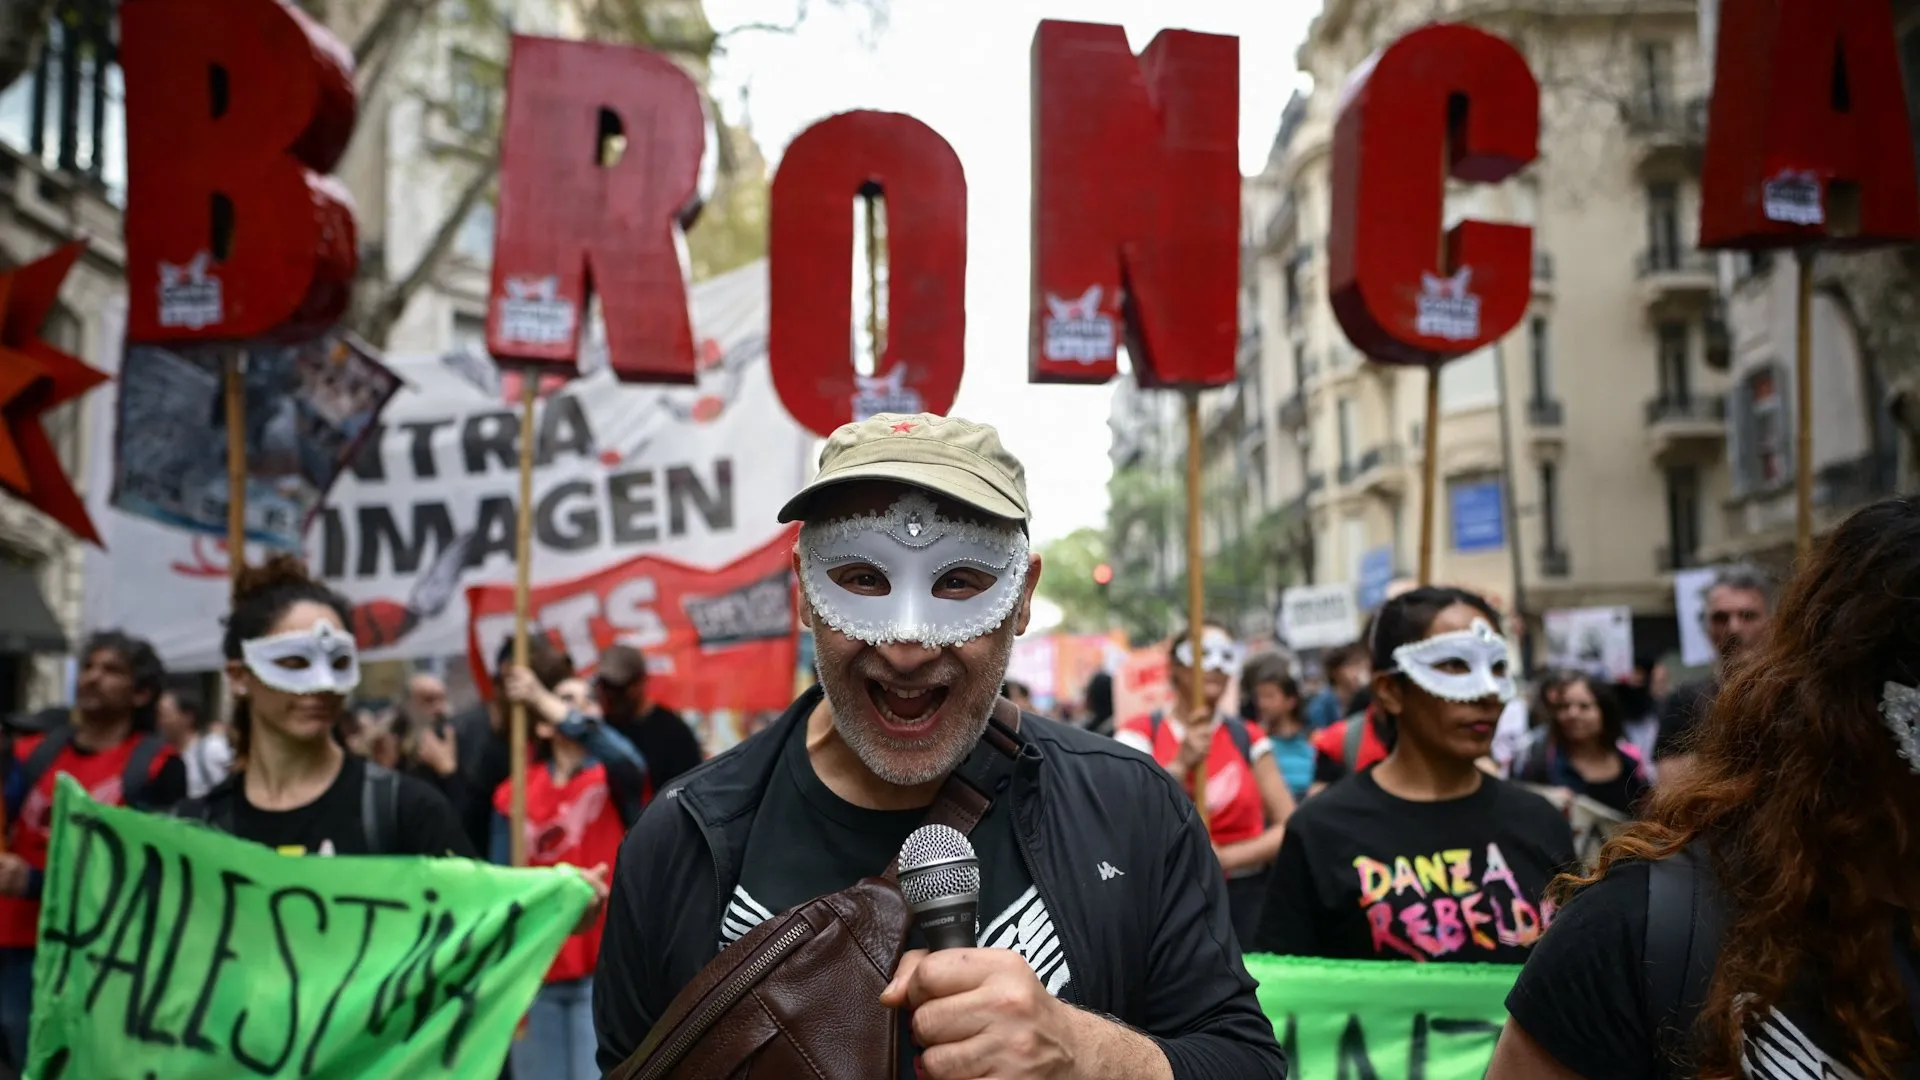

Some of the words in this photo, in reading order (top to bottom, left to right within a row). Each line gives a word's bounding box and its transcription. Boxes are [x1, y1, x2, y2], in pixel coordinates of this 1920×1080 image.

[119, 0, 1920, 436] BRONCA
[321, 459, 734, 579] IMAGEN
[1353, 842, 1526, 908] DANZA
